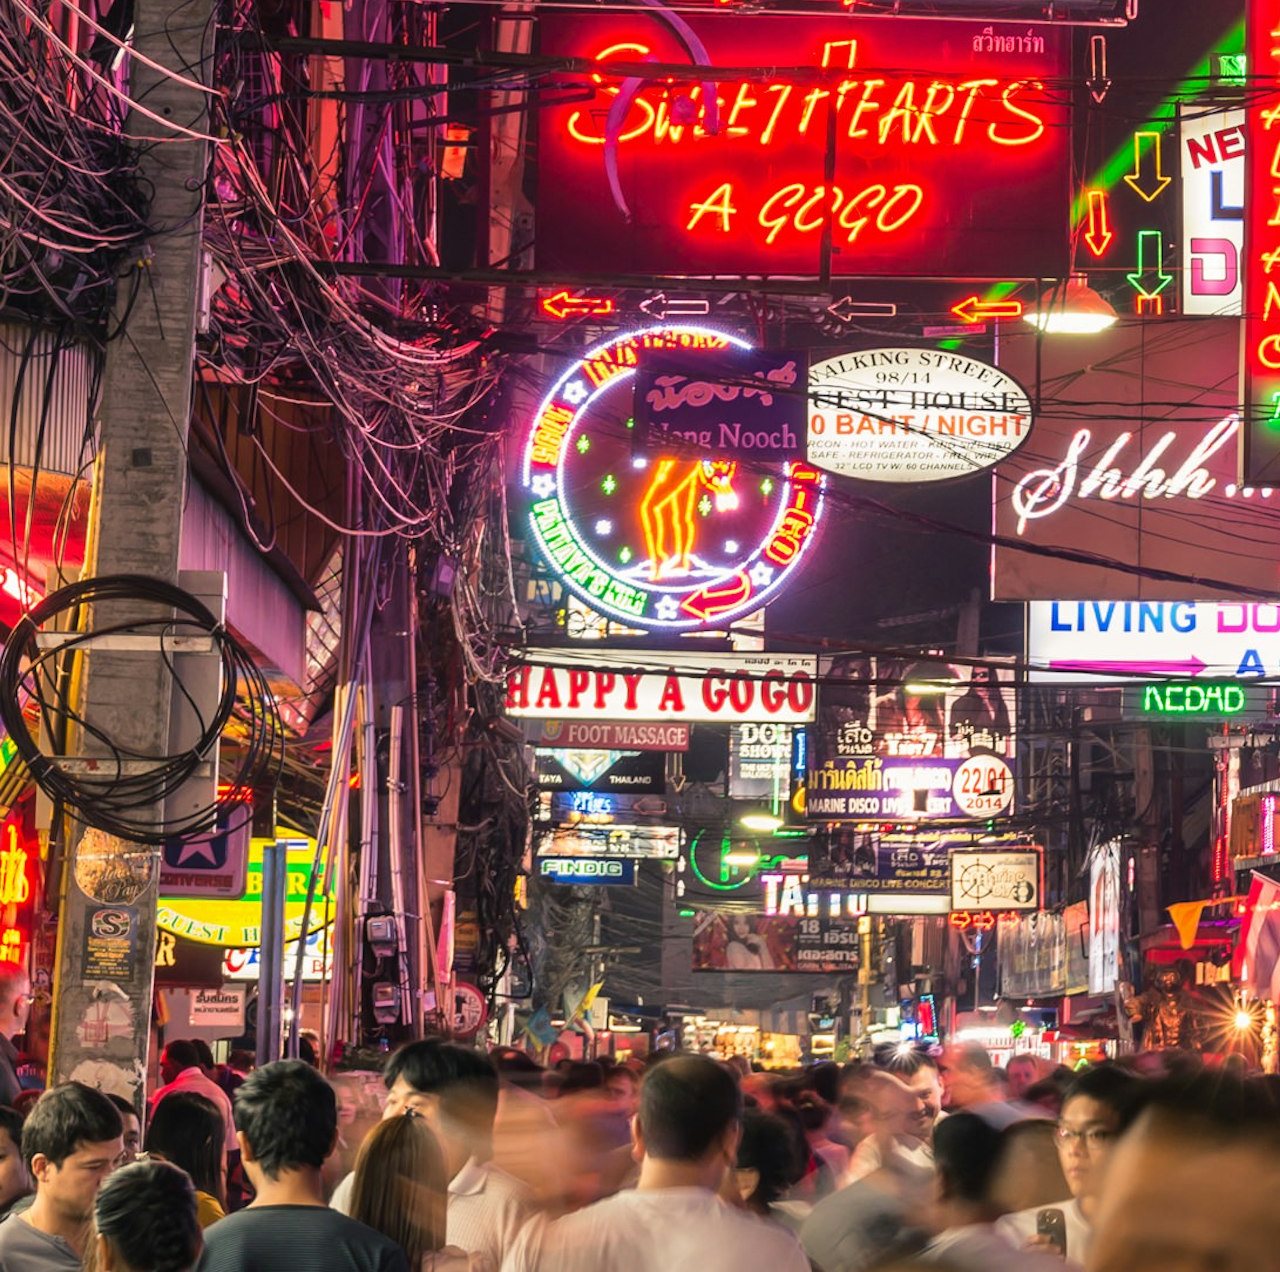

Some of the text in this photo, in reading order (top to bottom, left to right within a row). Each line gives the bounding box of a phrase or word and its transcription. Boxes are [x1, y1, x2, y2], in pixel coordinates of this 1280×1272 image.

[972, 26, 1044, 53] สวีทฮาร์ท
[687, 183, 736, 232] A
[876, 372, 931, 385] 98/14
[919, 352, 1010, 388] STREET
[813, 390, 1022, 412] UEST HOUSE
[718, 423, 798, 450] Nooch
[836, 414, 915, 436] BAHT
[938, 414, 1028, 436] NIGHT
[852, 441, 876, 450] HOT
[878, 441, 919, 450] WATER
[1050, 600, 1197, 634] LIVING
[1236, 649, 1267, 677] A
[505, 664, 814, 714] HAPPY A GOGO
[568, 723, 688, 746] FOOT MASSAGE
[808, 798, 846, 813] MARINE
[848, 798, 880, 814] DISCO
[966, 797, 1003, 809] 2014
[800, 919, 820, 934] 18
